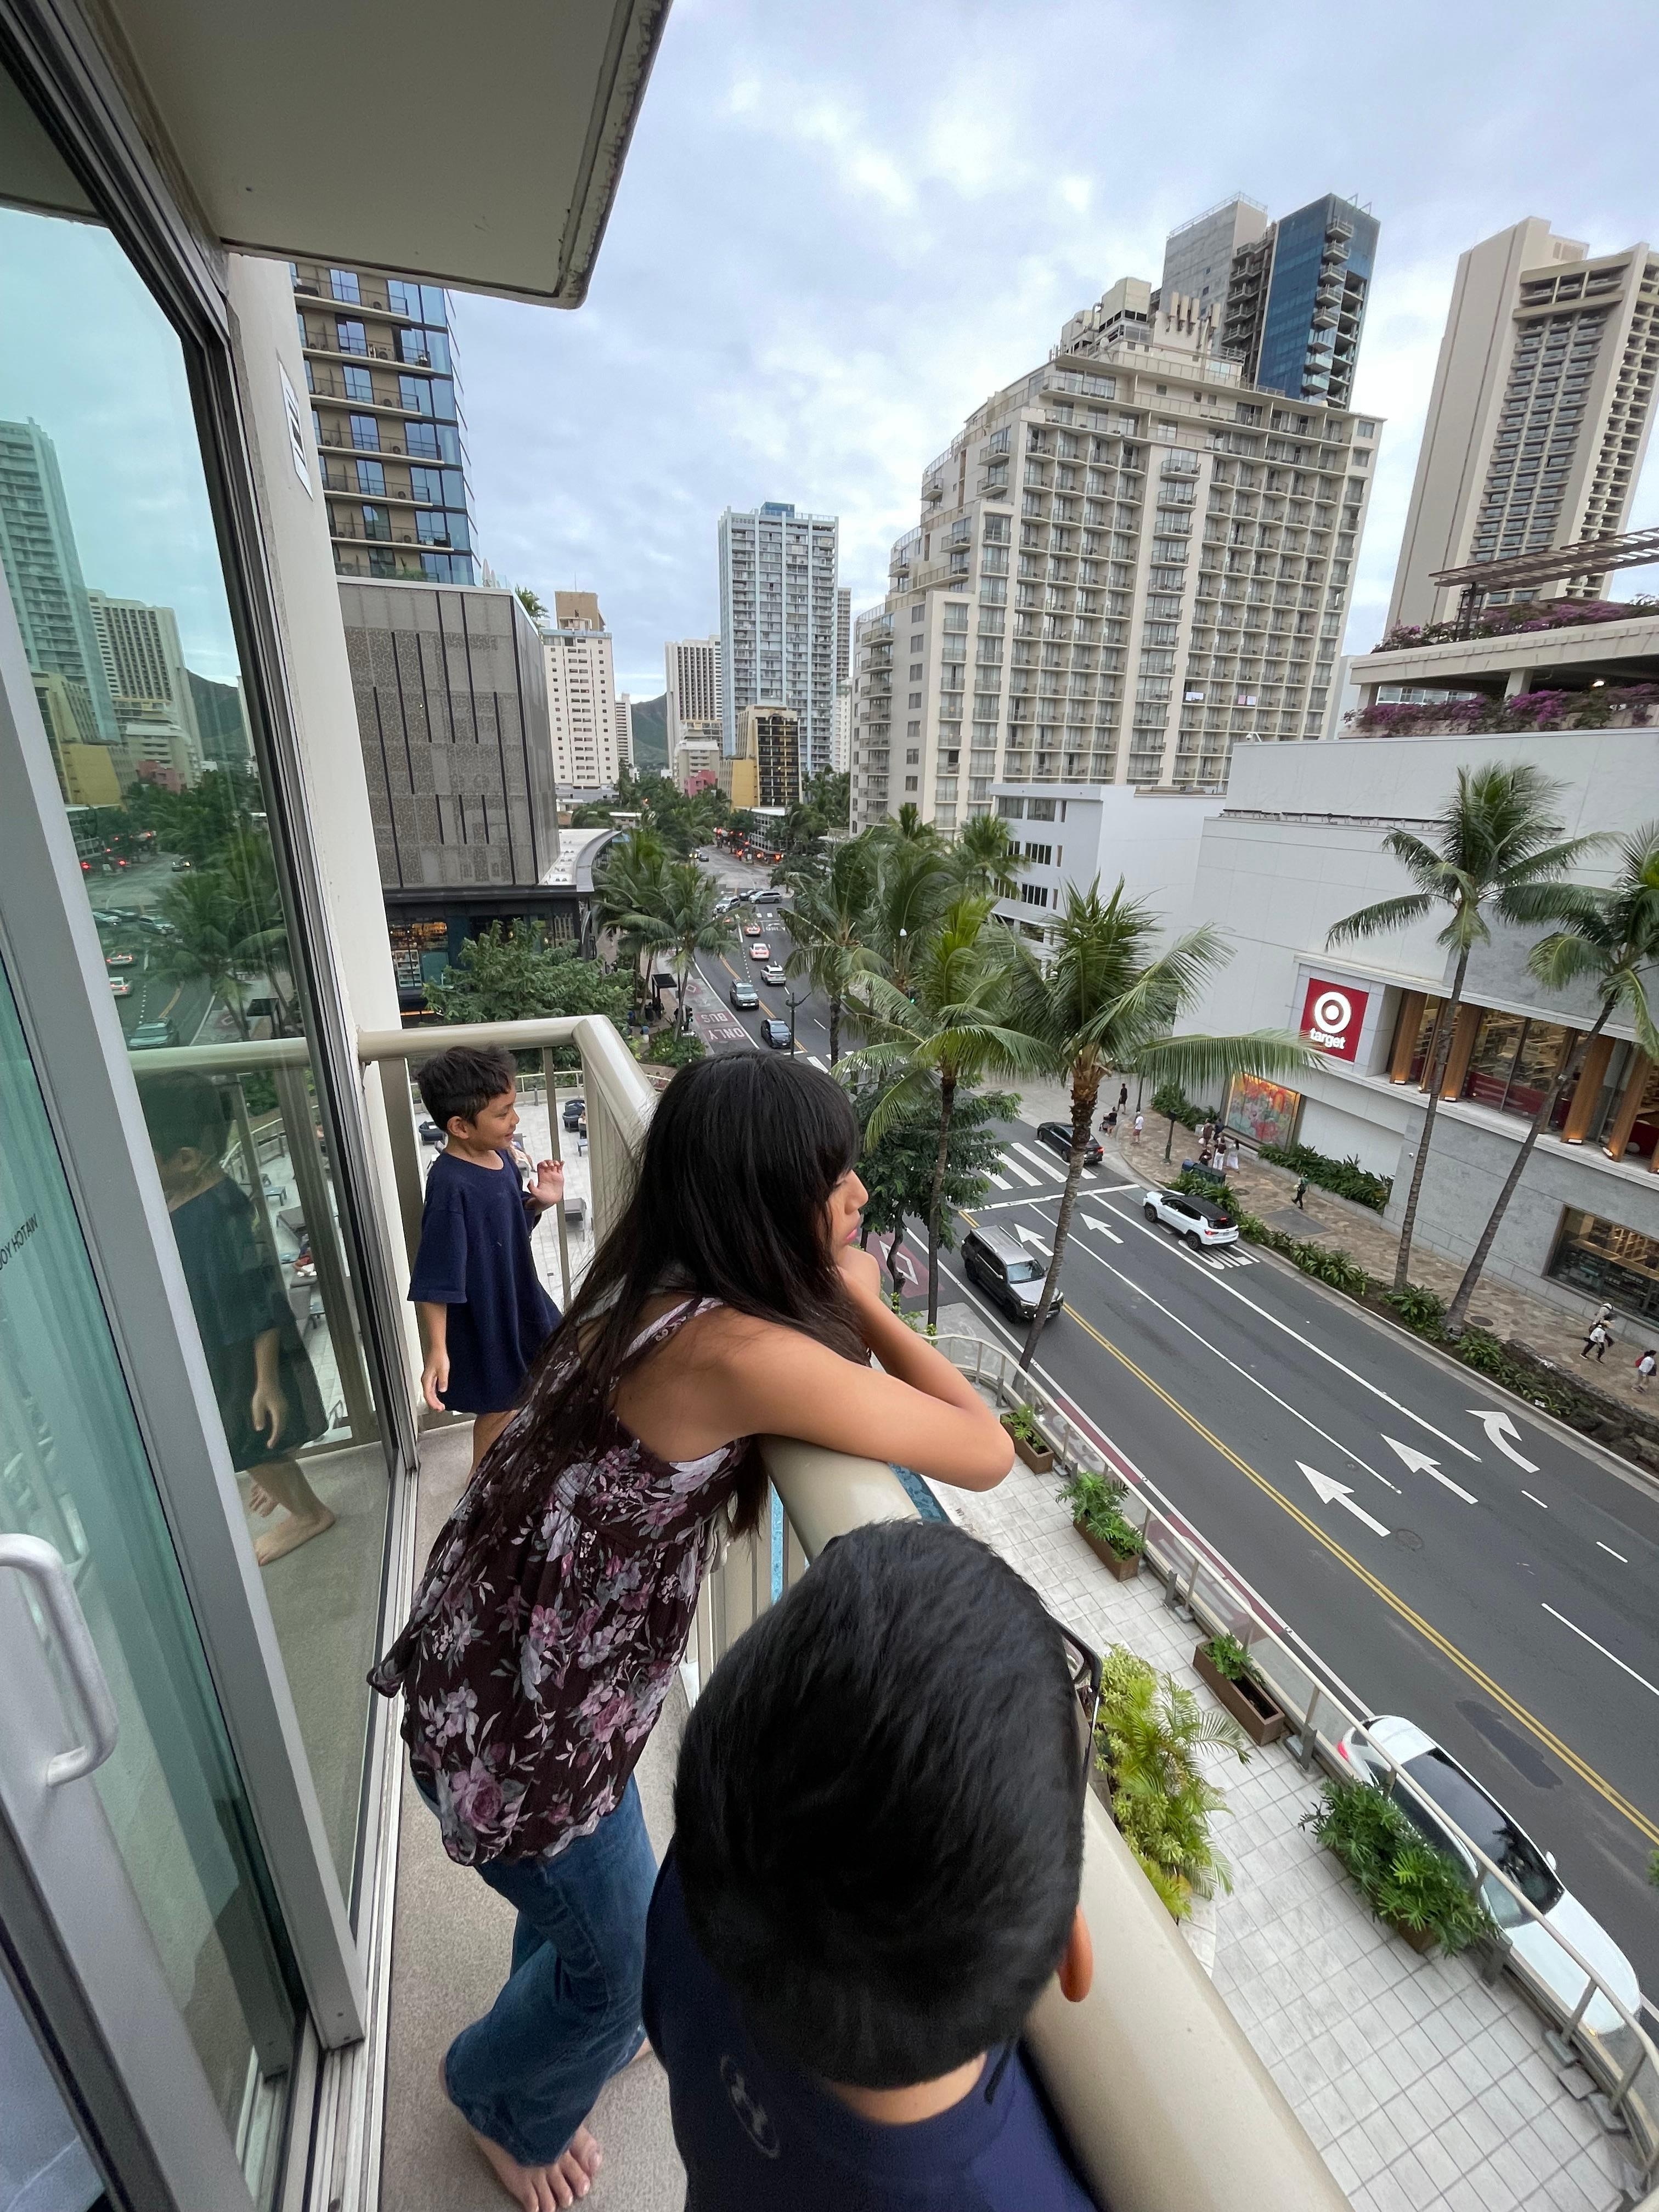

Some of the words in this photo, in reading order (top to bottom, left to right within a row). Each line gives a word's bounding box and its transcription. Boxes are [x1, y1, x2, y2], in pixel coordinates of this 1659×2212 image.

[701, 1013, 728, 1023] BUS
[708, 1028, 745, 1040] ONLY
[1310, 1028, 1346, 1049] target
